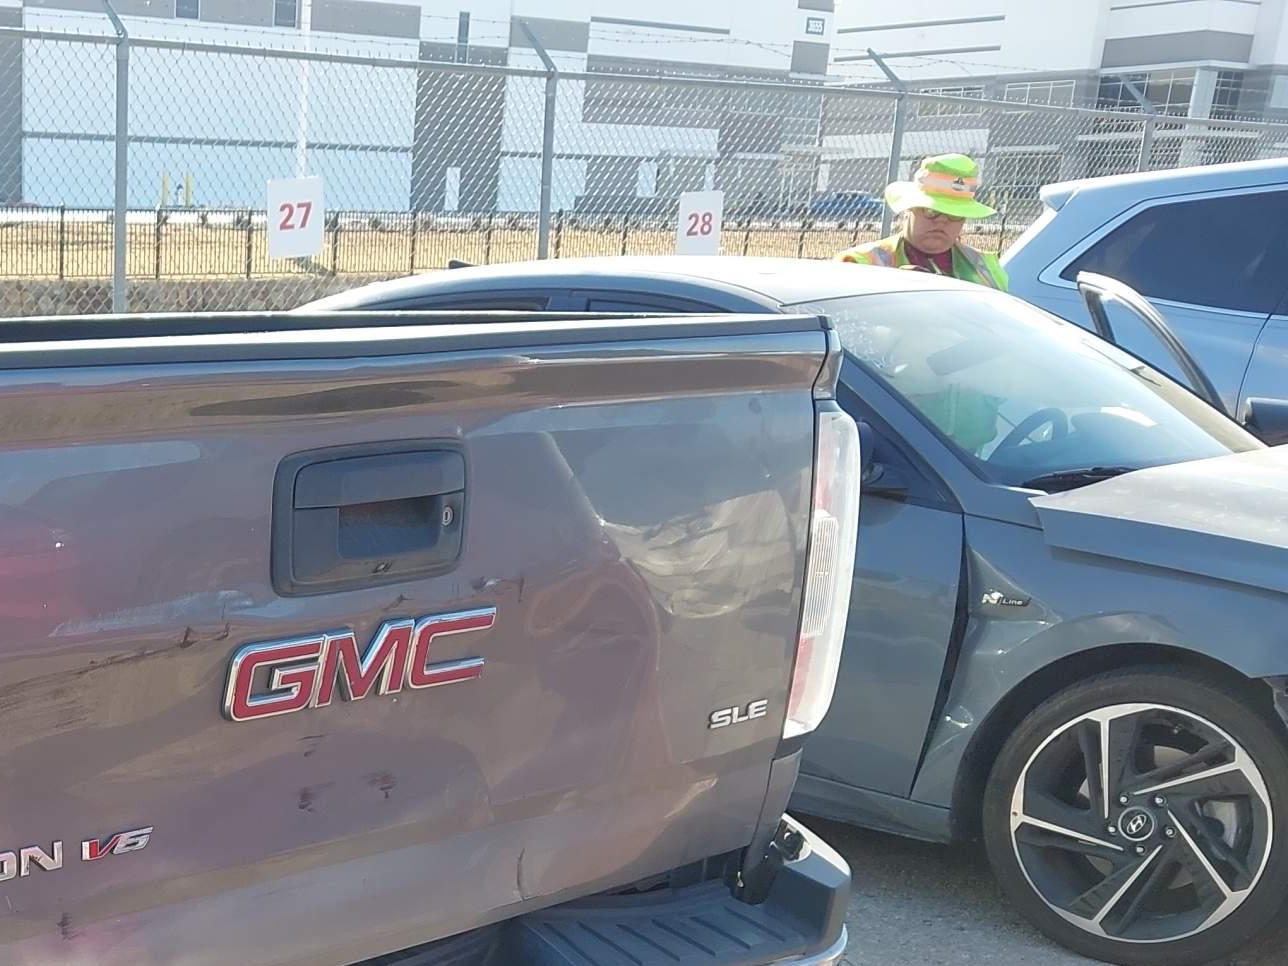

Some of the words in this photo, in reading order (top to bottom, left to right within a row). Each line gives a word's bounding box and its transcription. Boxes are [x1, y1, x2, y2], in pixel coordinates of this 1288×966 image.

[279, 201, 312, 231] 27
[686, 212, 713, 236] 28
[222, 606, 497, 722] GMC
[708, 698, 769, 729] SLE
[81, 826, 154, 861] V6
